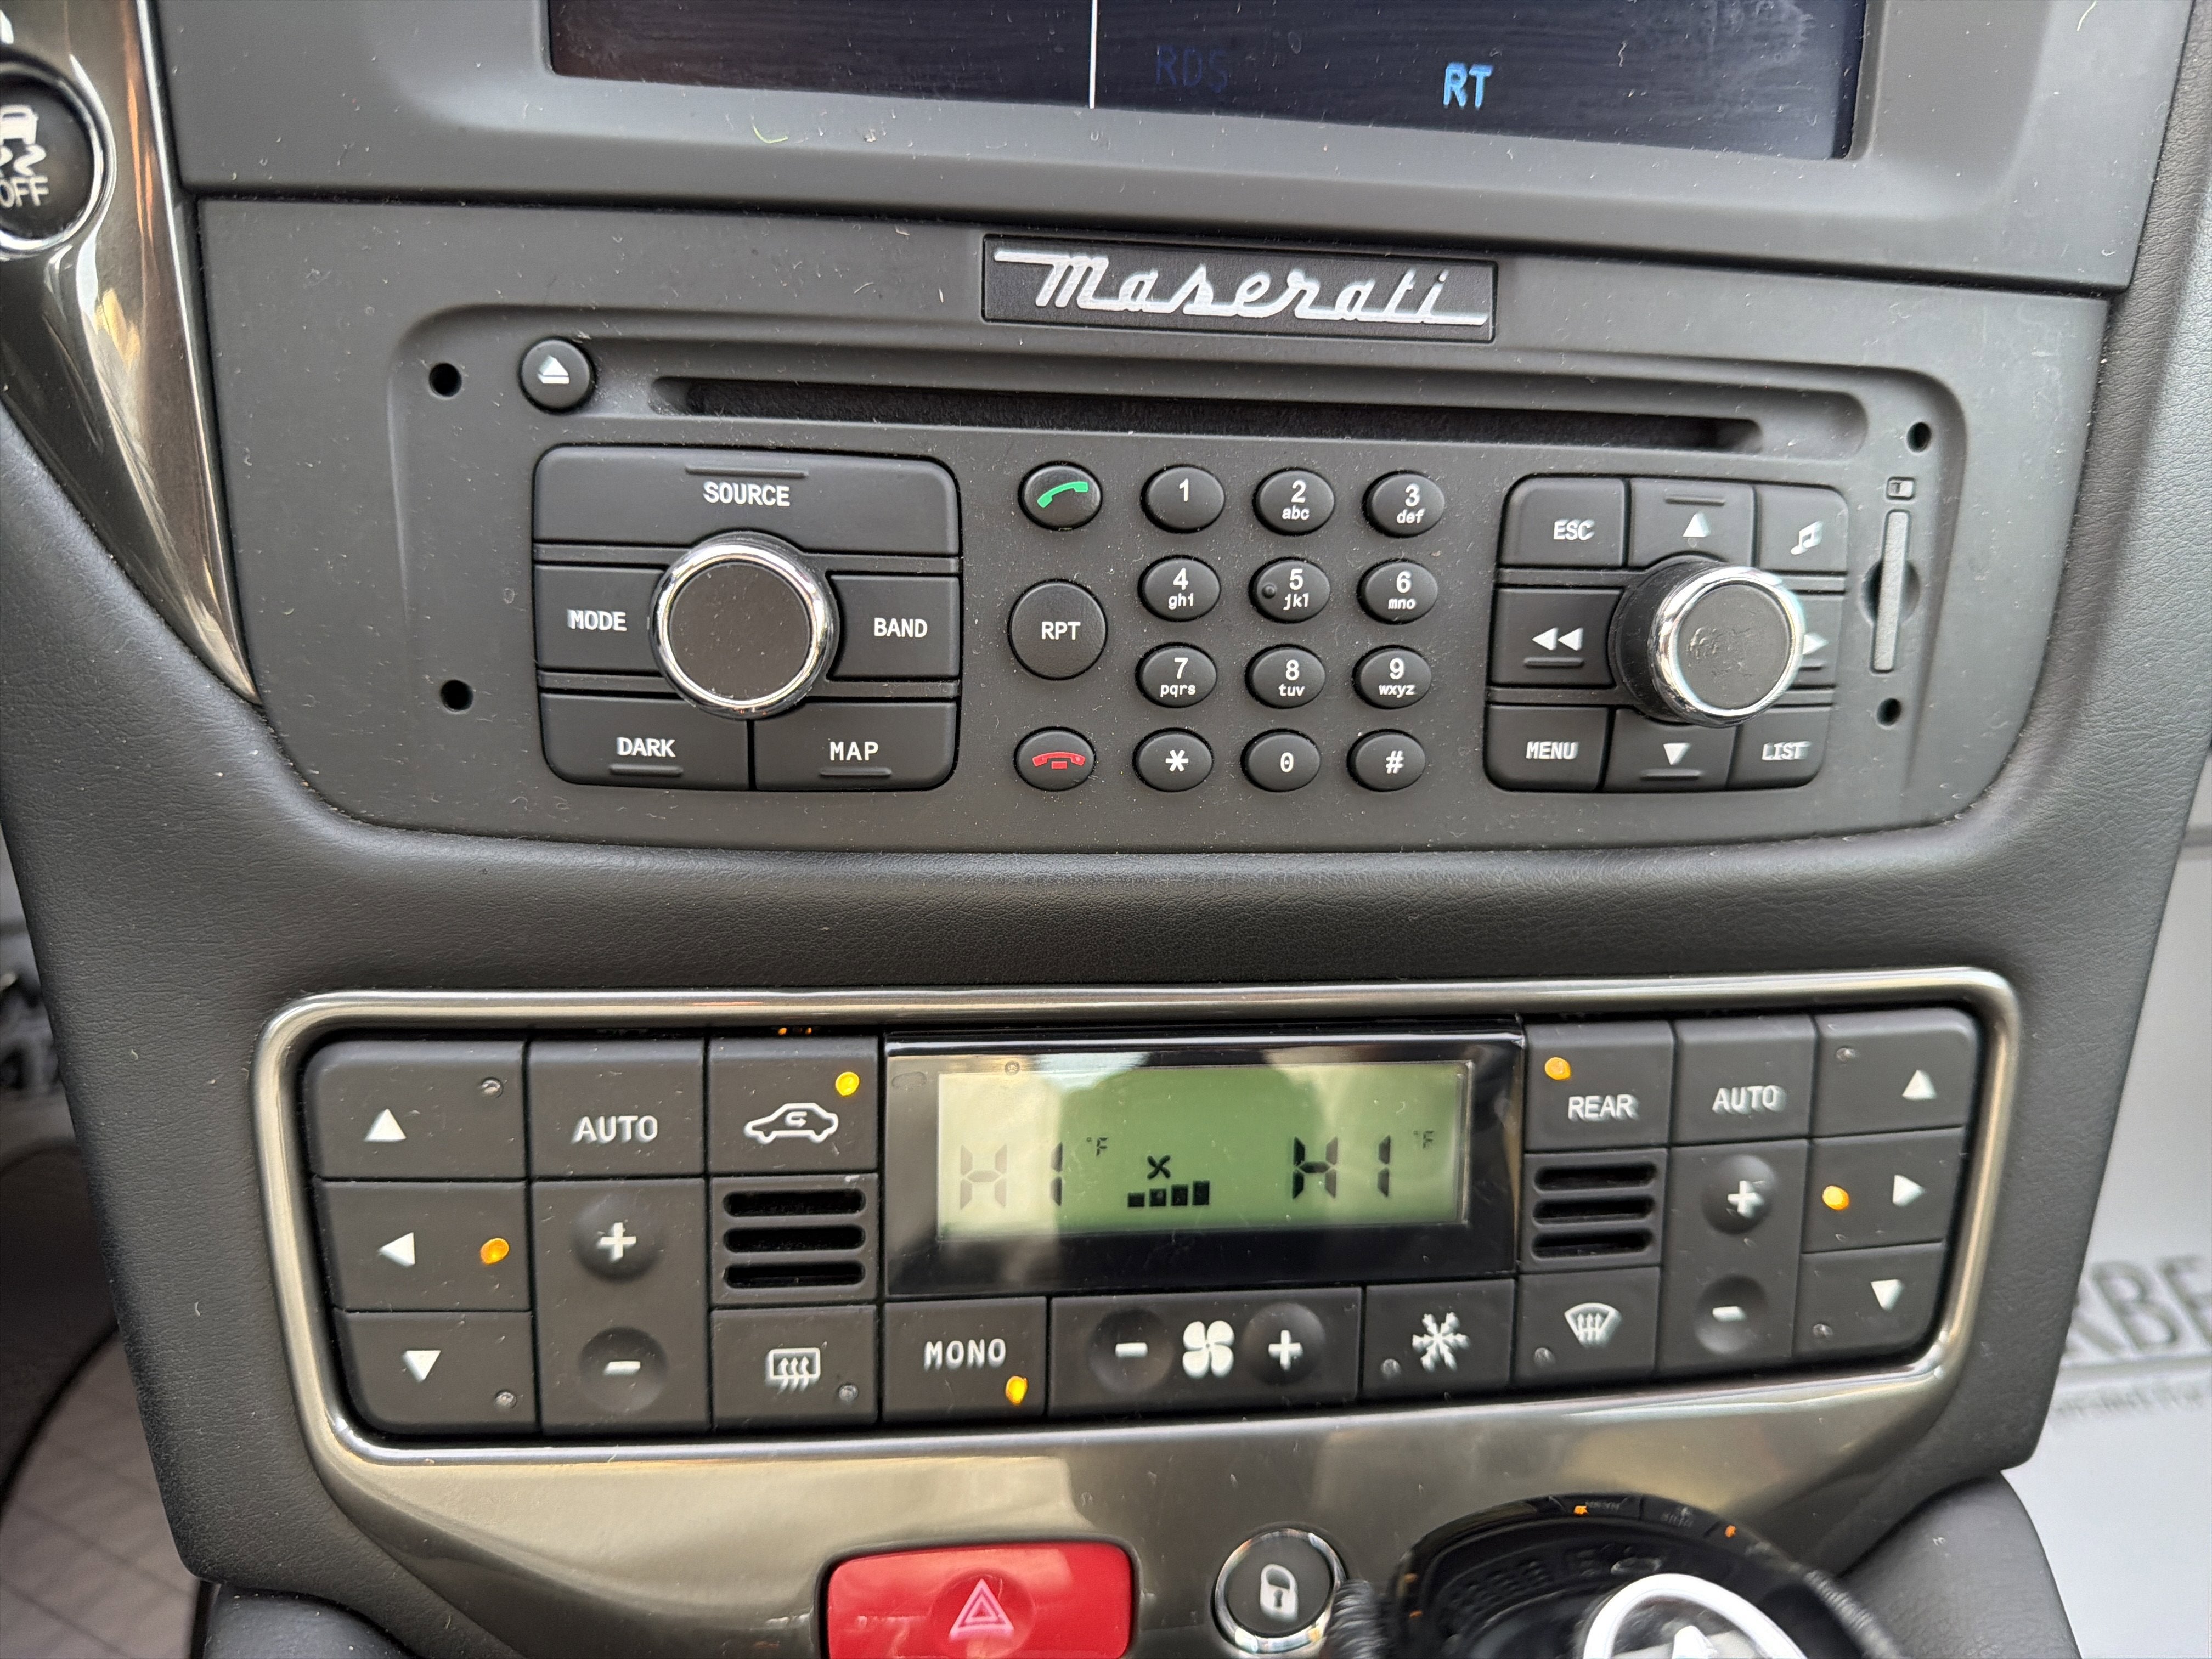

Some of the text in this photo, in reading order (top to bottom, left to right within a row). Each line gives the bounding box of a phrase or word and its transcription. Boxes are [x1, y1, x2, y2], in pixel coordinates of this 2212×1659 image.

[1156, 45, 1228, 93] RDS
[1443, 63, 1493, 110] RT
[994, 250, 1488, 325] Maserati
[703, 482, 790, 506] SOURCE
[1180, 478, 1188, 501] 1
[1291, 480, 1306, 503] 2
[1406, 484, 1420, 506] 3
[1282, 505, 1309, 520] abc
[1397, 508, 1425, 524] def
[1554, 520, 1594, 540] ESC
[1173, 567, 1189, 590] 4
[1290, 568, 1303, 590] 5
[1397, 571, 1412, 592] 6
[1283, 592, 1309, 611] jkl
[1388, 599, 1416, 609] mno
[568, 610, 627, 631] MODE
[874, 618, 927, 637] BAND
[1042, 622, 1081, 640] RPT
[1175, 658, 1188, 679] 7
[1286, 659, 1300, 679] 8
[1390, 658, 1404, 679] 9
[1160, 685, 1195, 697] pqrs
[1279, 684, 1305, 696] tuv
[1379, 685, 1415, 698] wxyz
[617, 737, 675, 757] DARK
[831, 742, 878, 760] MAP
[1526, 742, 1577, 759] MENU
[1762, 741, 1810, 760] LIST
[1280, 752, 1294, 772] 0
[1568, 1094, 1635, 1120] REAR
[1713, 1085, 1782, 1112] AUTO
[573, 1116, 657, 1143] AUTO
[1292, 1134, 1391, 1200] HI
[924, 1339, 1006, 1368] MONO
